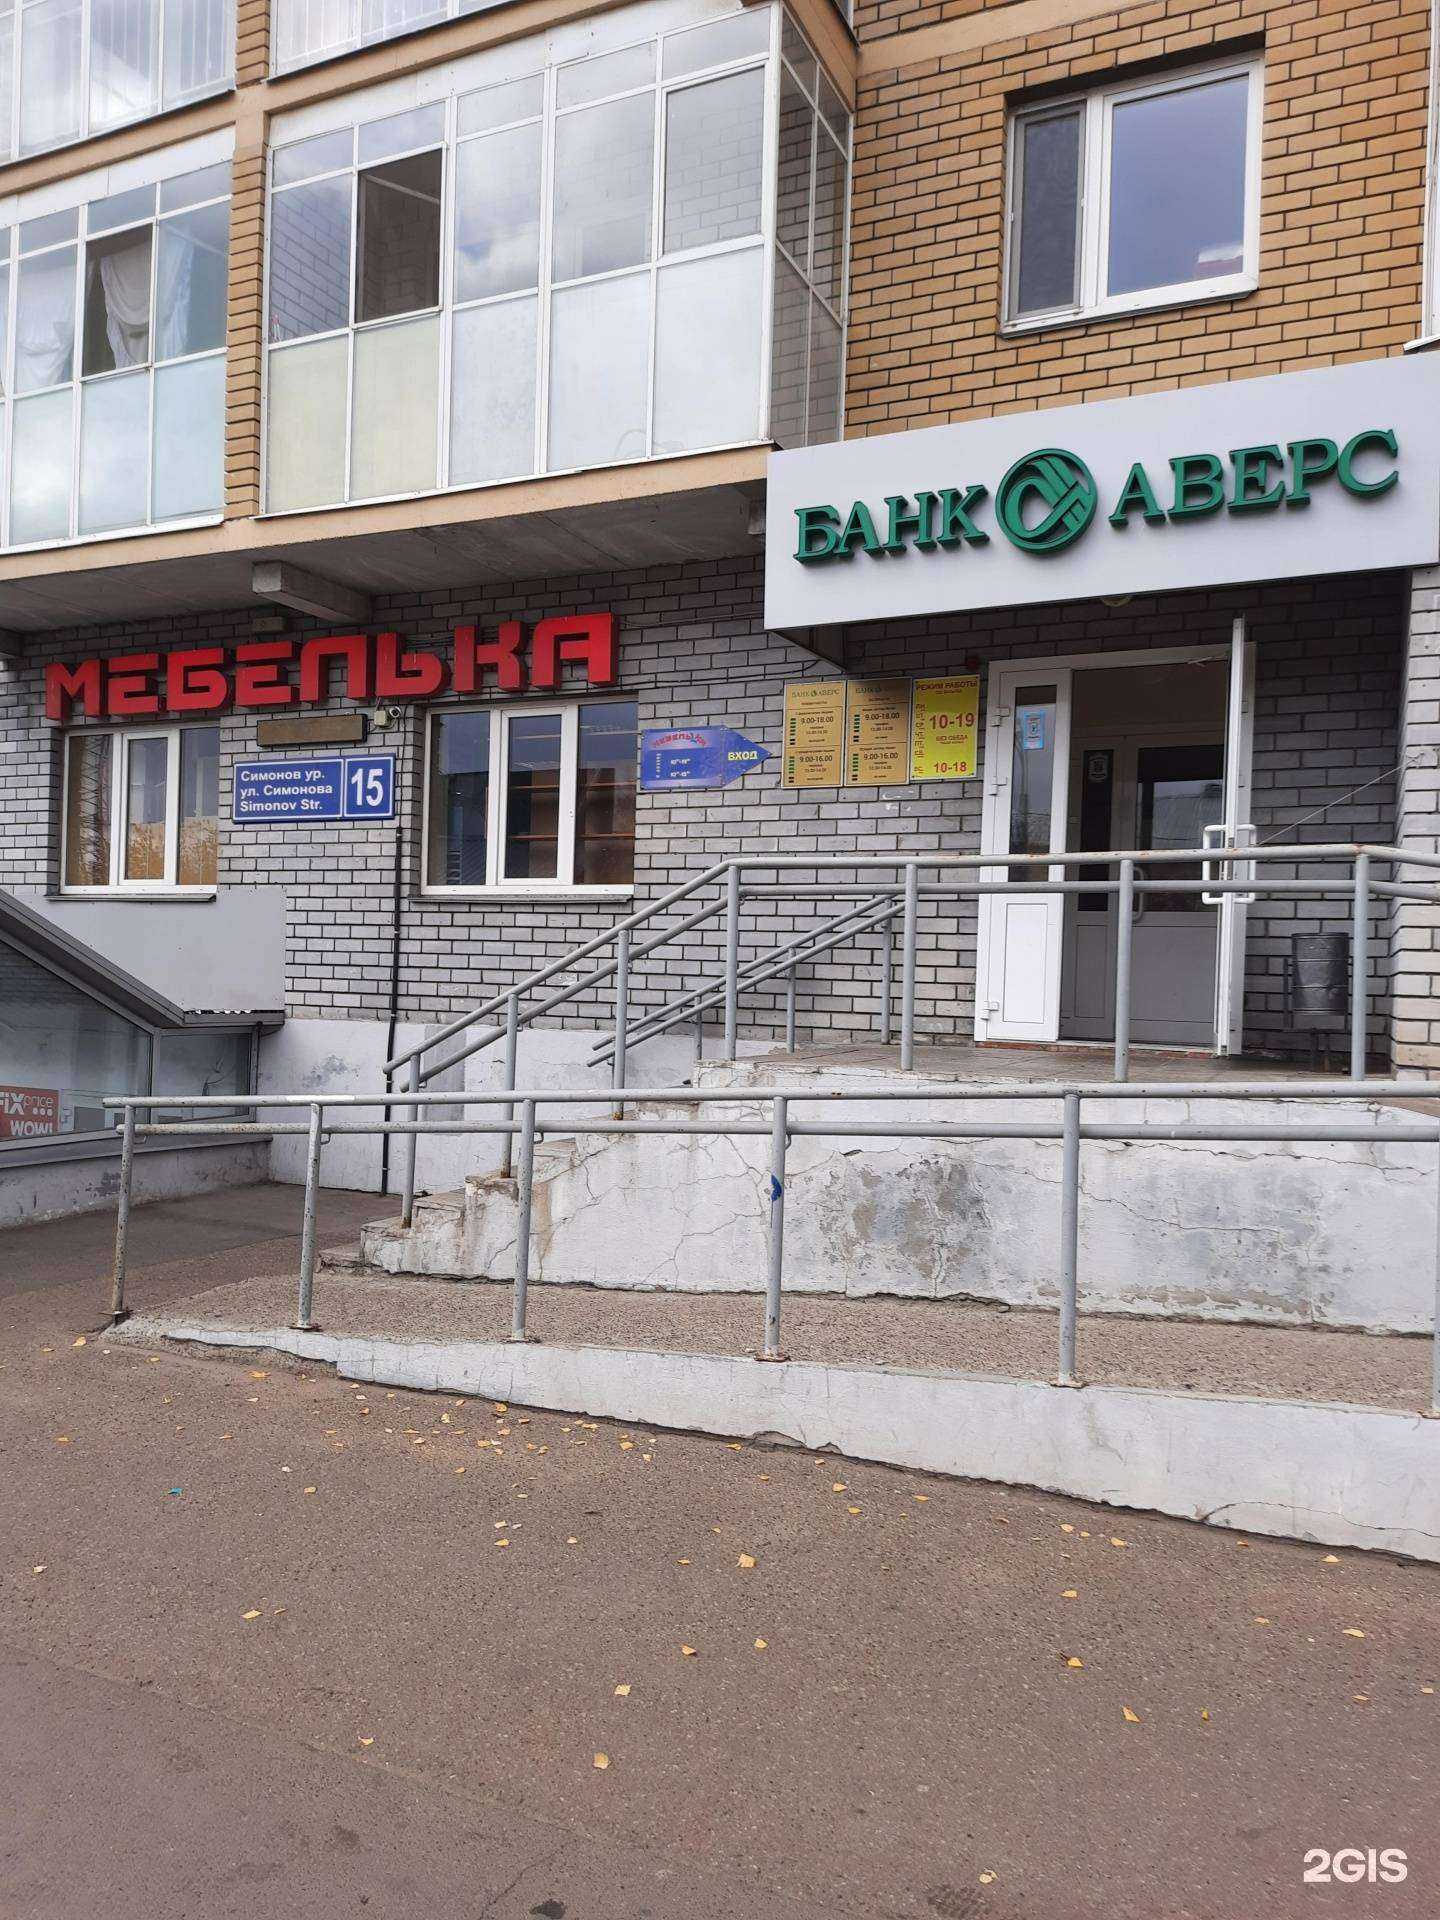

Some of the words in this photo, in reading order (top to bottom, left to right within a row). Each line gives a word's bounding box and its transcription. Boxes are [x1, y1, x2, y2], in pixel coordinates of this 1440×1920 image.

[793, 484, 990, 565] БАНК
[1108, 428, 1400, 528] АВЕРС
[45, 612, 619, 720] МЕБЕЛЬКА
[929, 713, 975, 730] 10-19
[728, 750, 758, 760] ВХОД
[934, 761, 967, 773] 10-18
[241, 770, 301, 782] Симонов
[305, 770, 325, 782] ур.
[240, 786, 260, 799] ул.
[263, 784, 333, 796] Симонова
[351, 768, 384, 807] 15
[240, 801, 297, 812] Simonov
[300, 799, 323, 810] Str.
[10, 1119, 53, 1137] WOW!
